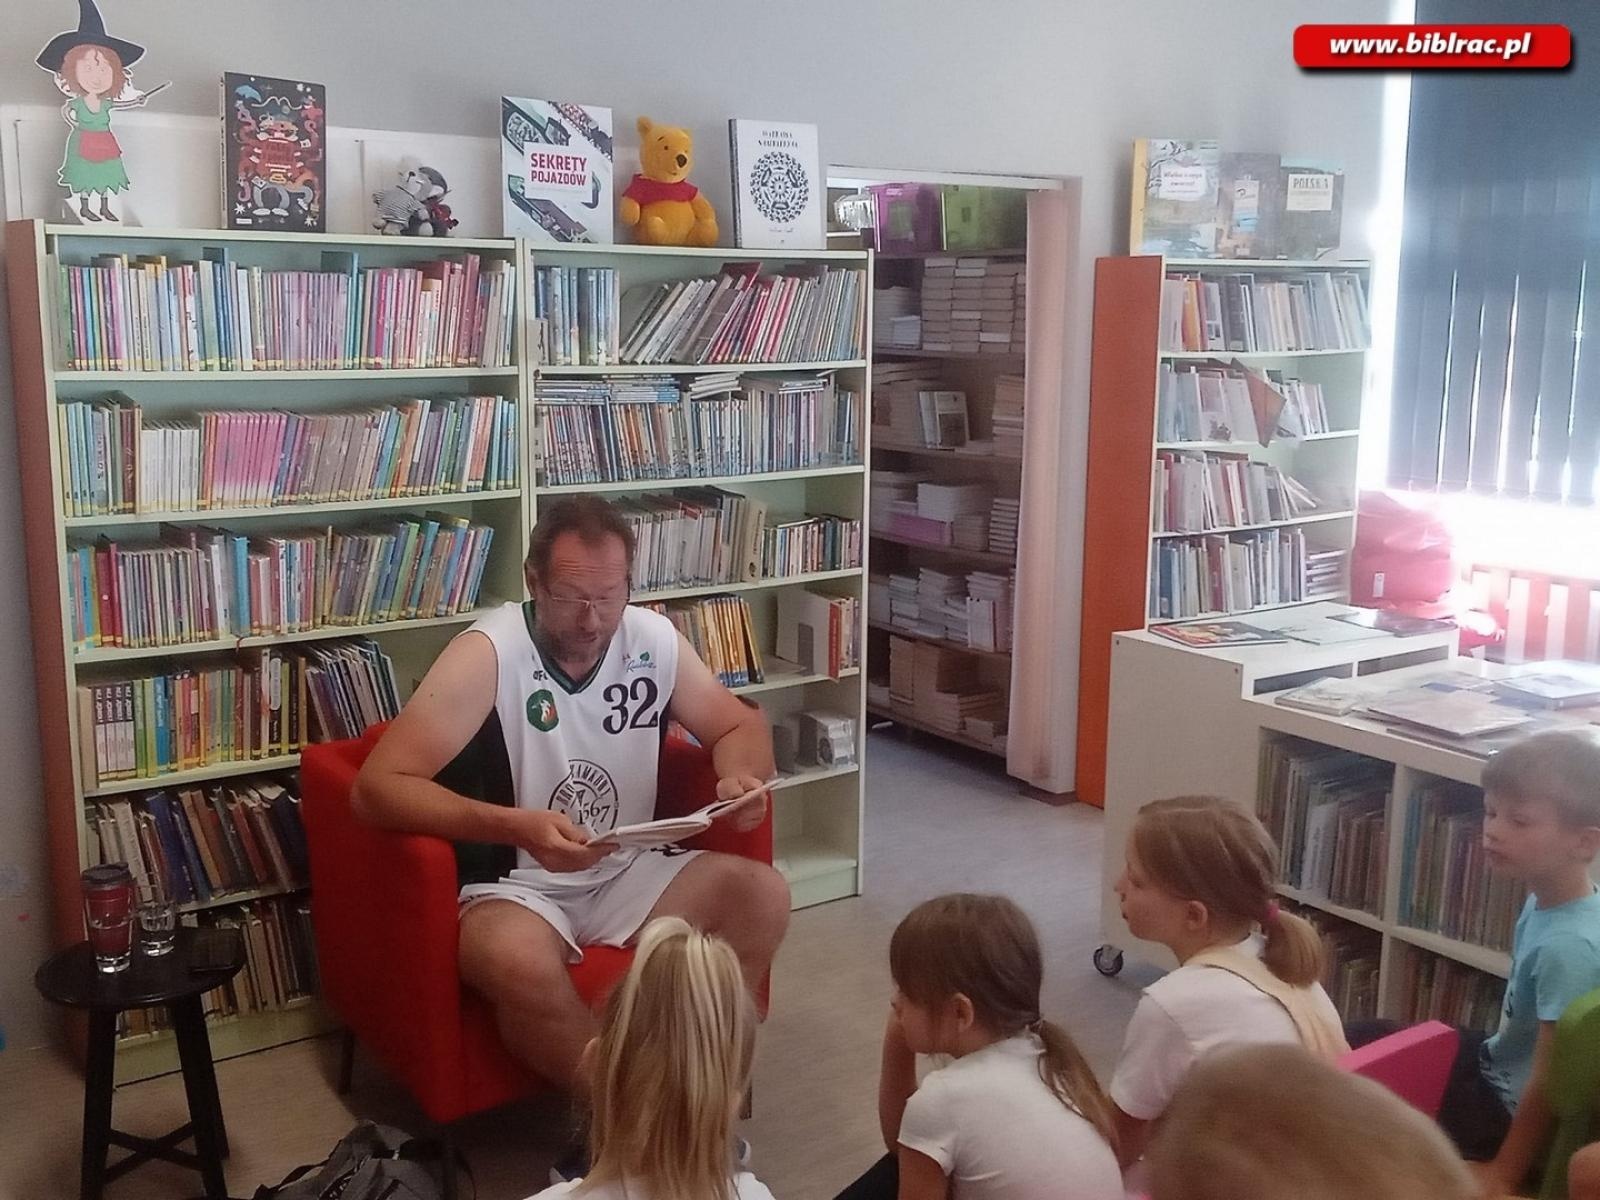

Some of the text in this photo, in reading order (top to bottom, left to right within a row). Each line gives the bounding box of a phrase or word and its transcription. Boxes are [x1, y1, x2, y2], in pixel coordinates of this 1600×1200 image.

[531, 153, 587, 172] SEKRETY
[531, 170, 587, 186] POJAZDÓW
[602, 676, 659, 735] 32
[577, 798, 611, 825] 1567
